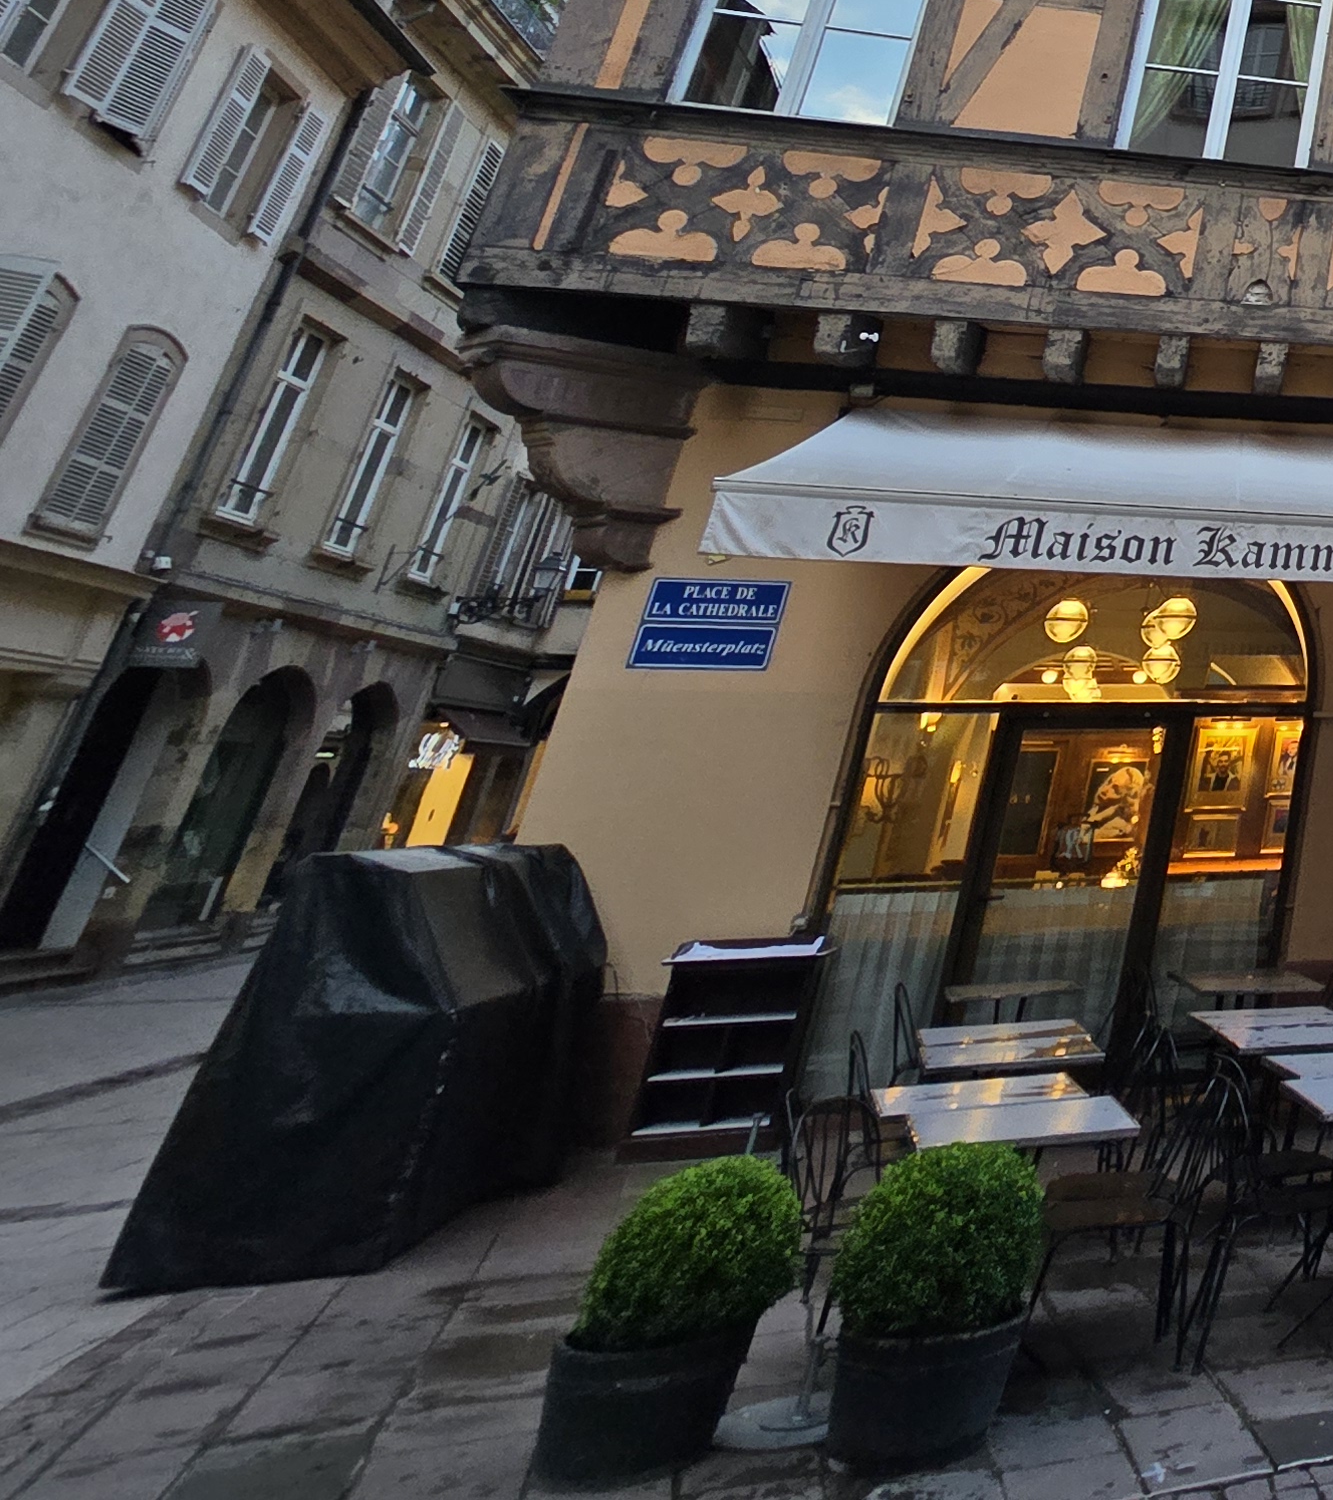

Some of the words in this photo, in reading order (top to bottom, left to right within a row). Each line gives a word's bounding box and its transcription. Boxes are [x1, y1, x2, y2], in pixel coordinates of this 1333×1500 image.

[977, 516, 1178, 567] Maison
[683, 585, 731, 600] PLACE
[735, 587, 757, 600] DE
[651, 602, 671, 615] LA
[678, 603, 777, 618] CATHEDRALE
[642, 639, 766, 657] Müensterplatz
